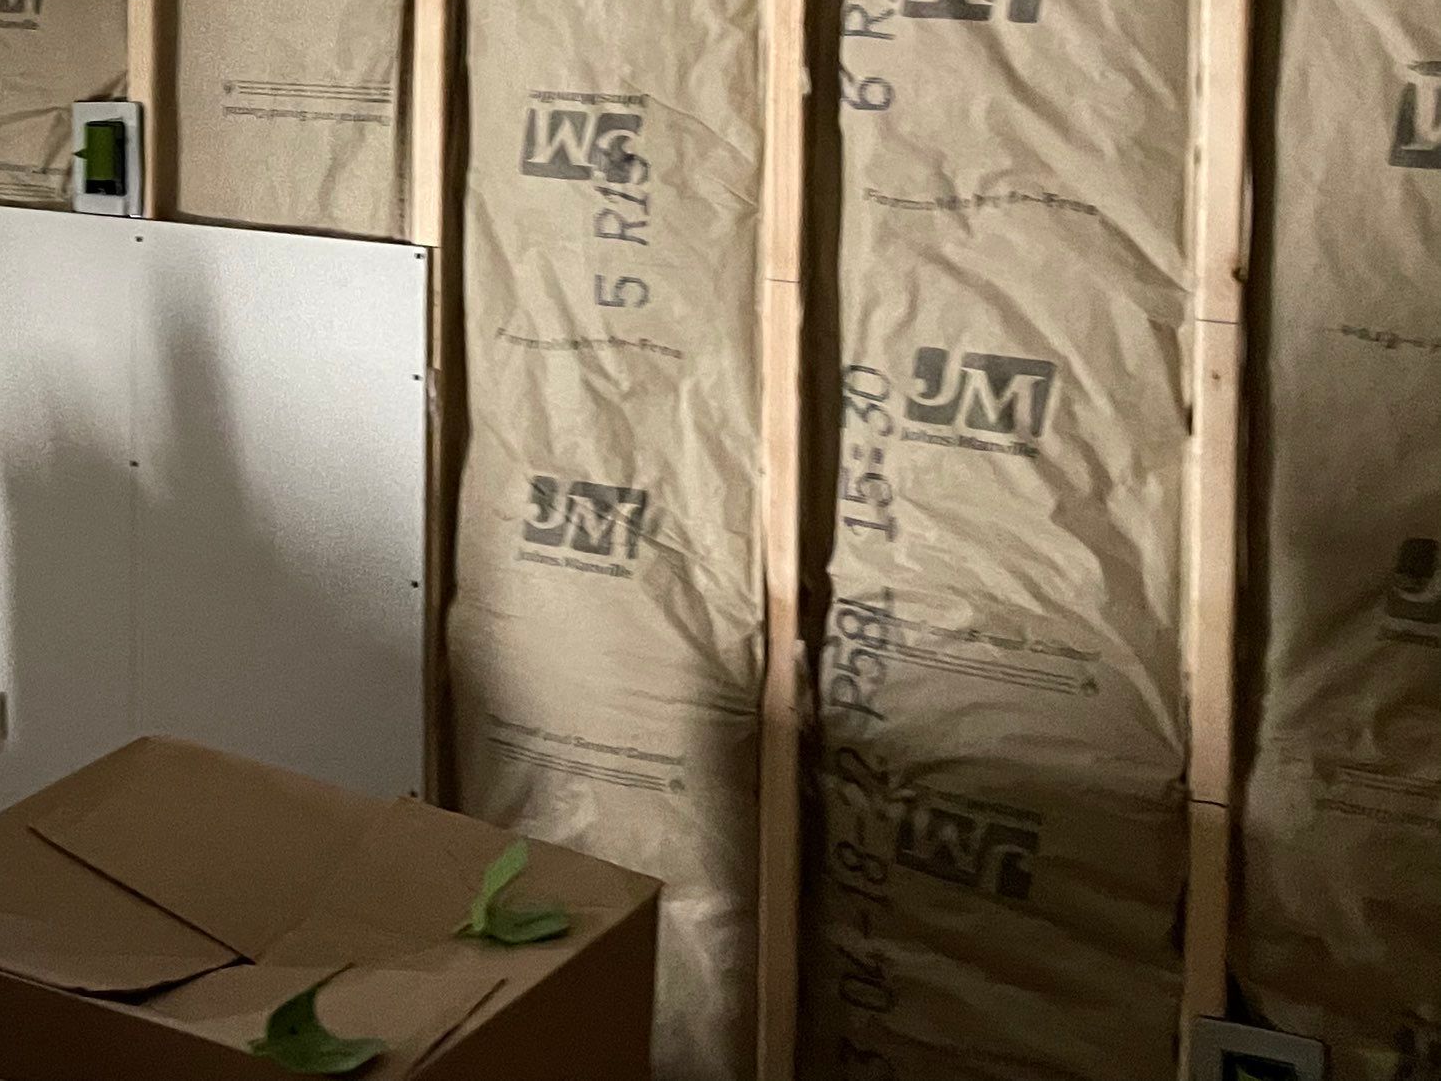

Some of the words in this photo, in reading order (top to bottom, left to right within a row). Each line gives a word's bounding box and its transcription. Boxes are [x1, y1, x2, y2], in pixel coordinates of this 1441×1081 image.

[840, 66, 895, 112] 6
[521, 107, 643, 184] JM
[592, 274, 652, 310] 5
[906, 346, 1057, 438] JM
[842, 364, 896, 543] 15:30
[524, 475, 647, 560] JM
[896, 807, 1042, 900] JM
